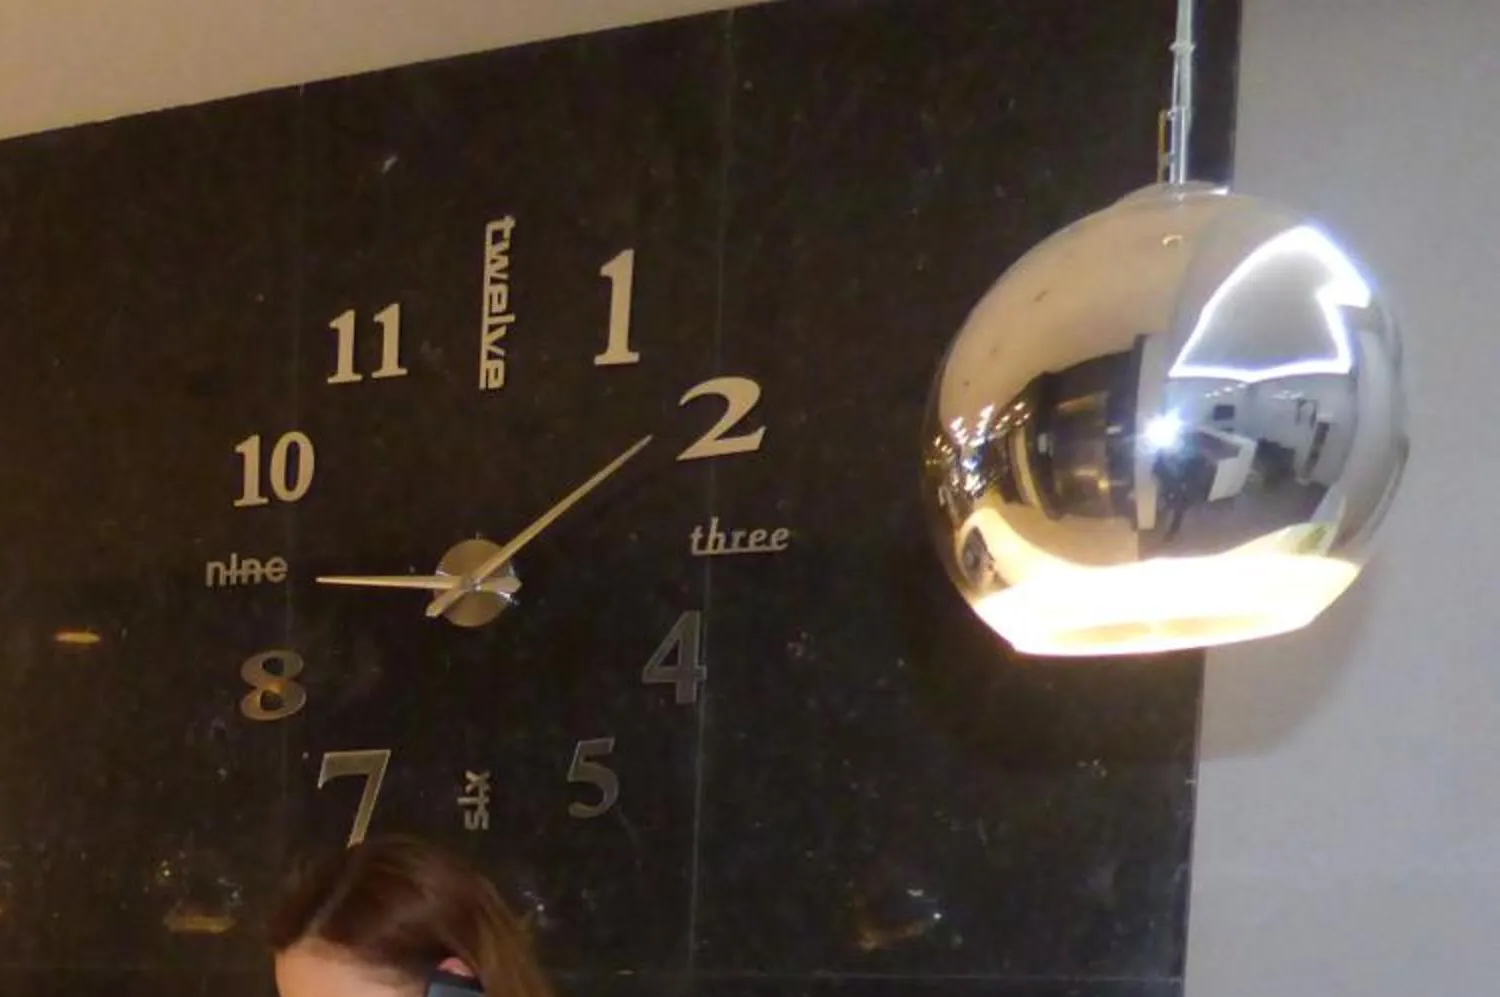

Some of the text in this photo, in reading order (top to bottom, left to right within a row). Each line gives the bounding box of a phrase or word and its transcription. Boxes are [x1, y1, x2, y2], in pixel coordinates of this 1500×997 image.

[479, 216, 516, 390] twelve
[594, 249, 640, 366] 1
[327, 303, 408, 384] 11
[676, 376, 766, 460] 2
[233, 432, 315, 507] 10
[205, 553, 288, 588] nine
[689, 517, 790, 556] three
[240, 650, 307, 721] 8
[641, 611, 707, 704] 4
[318, 750, 391, 848] 7
[458, 769, 490, 831] six
[569, 738, 620, 817] 5
